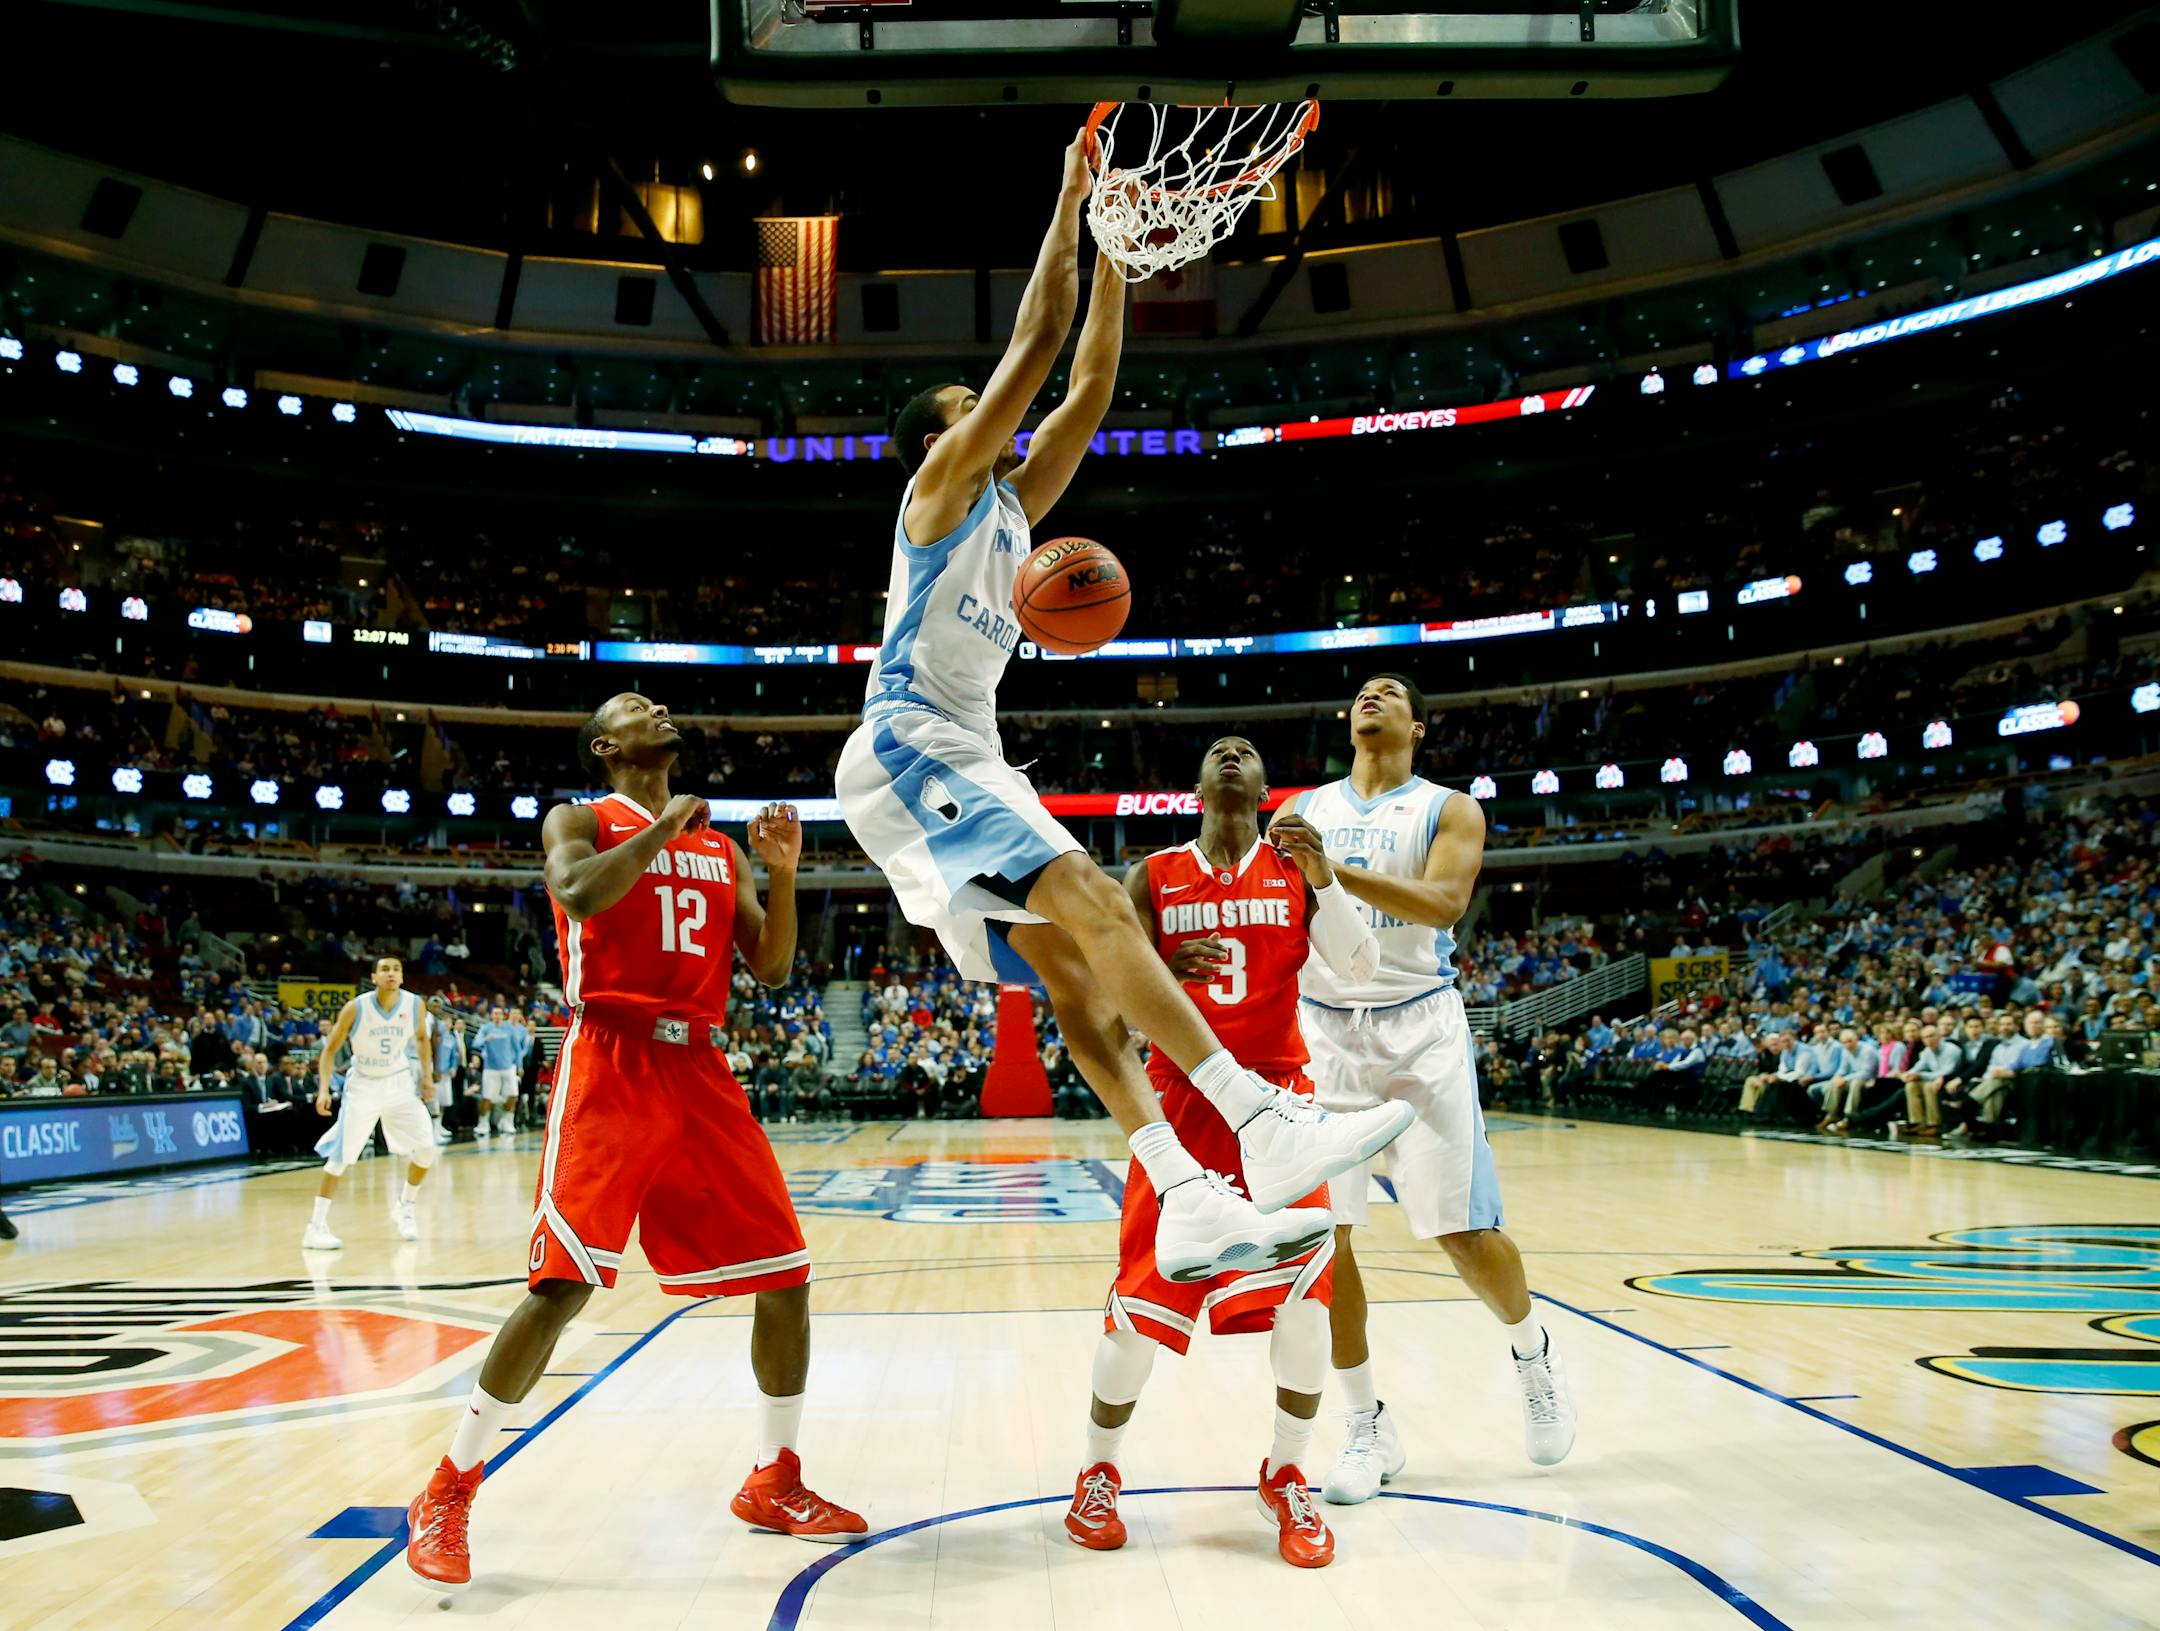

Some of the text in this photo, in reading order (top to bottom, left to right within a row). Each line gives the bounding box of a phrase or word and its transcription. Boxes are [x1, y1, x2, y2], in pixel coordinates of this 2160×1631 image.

[1833, 328, 1886, 353] BUD
[1886, 305, 1972, 338] LIGHT
[1972, 262, 2112, 315] LEGENDS
[511, 426, 618, 449] TAR HEELS
[1351, 408, 1457, 435] BUCKEYES
[766, 430, 1203, 463] UNIT CNTER
[353, 628, 410, 645] 12:07 PM
[957, 594, 1022, 653] CAROL
[1116, 794, 1203, 817] BUCKE
[1321, 827, 1398, 853] NORTH
[674, 850, 732, 885] STATE
[654, 885, 707, 958] 12
[1161, 898, 1291, 935] OHIO STATE
[1207, 937, 1248, 1006] 3
[318, 989, 351, 1007] CBS
[379, 1038, 391, 1054] 5
[2, 1120, 82, 1159] CLASSIC
[208, 1110, 242, 1144] CBS
